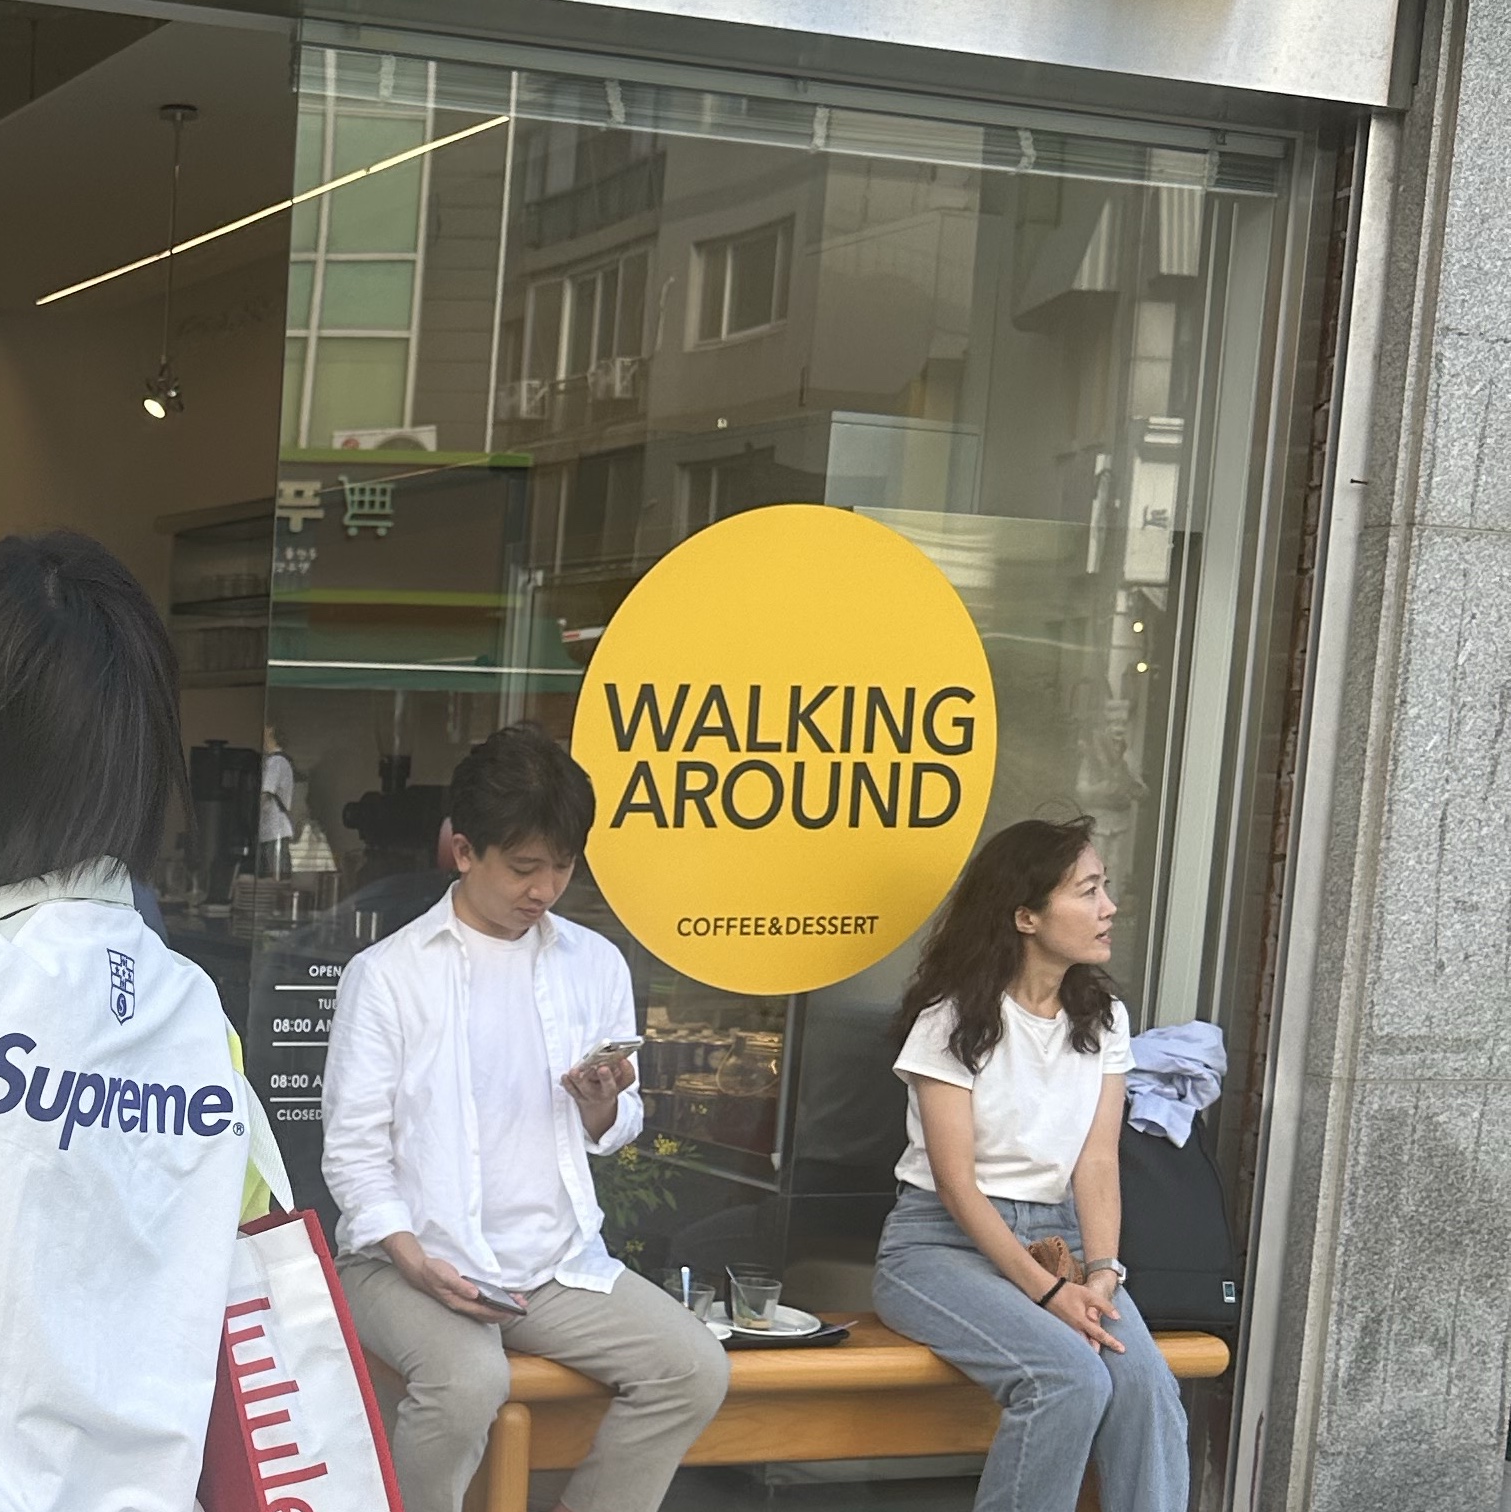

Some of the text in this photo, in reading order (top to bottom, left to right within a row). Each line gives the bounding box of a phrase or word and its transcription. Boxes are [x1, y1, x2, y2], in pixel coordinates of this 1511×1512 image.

[604, 683, 976, 755] WALKING
[609, 759, 962, 830] AROUND
[677, 915, 879, 937] COFFEE&DESSERT
[308, 965, 342, 977] OPEN
[273, 1018, 311, 1033] 08:00
[270, 1074, 309, 1089] 08:00
[276, 1109, 323, 1121] CLOSED
